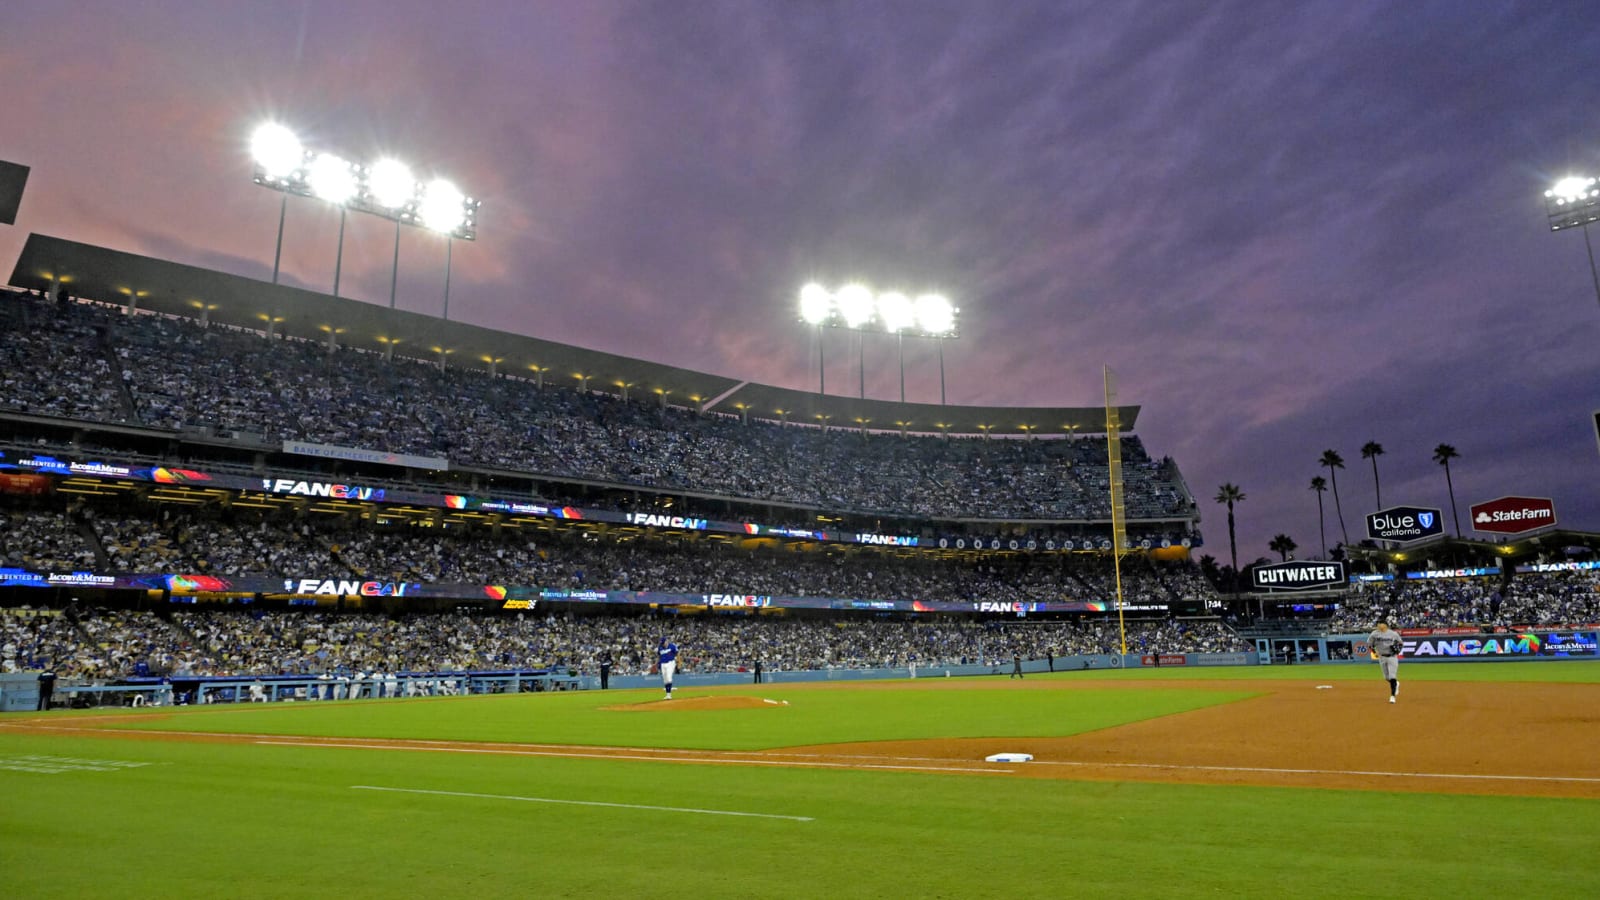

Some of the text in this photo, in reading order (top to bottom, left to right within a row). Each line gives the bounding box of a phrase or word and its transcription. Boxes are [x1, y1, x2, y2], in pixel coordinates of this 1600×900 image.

[294, 446, 379, 461] BANK OF AMERICA
[18, 459, 55, 468] PRESENTED
[273, 479, 385, 502] FANCAM
[634, 513, 707, 530] FANCAM
[1373, 514, 1414, 530] blue
[1493, 508, 1550, 522] State Farm
[861, 533, 918, 546] FANCAM
[1381, 528, 1421, 537] california
[1258, 566, 1336, 583] CUTWATER
[1427, 568, 1485, 578] FANCAM
[1399, 638, 1530, 656] FANCAM
